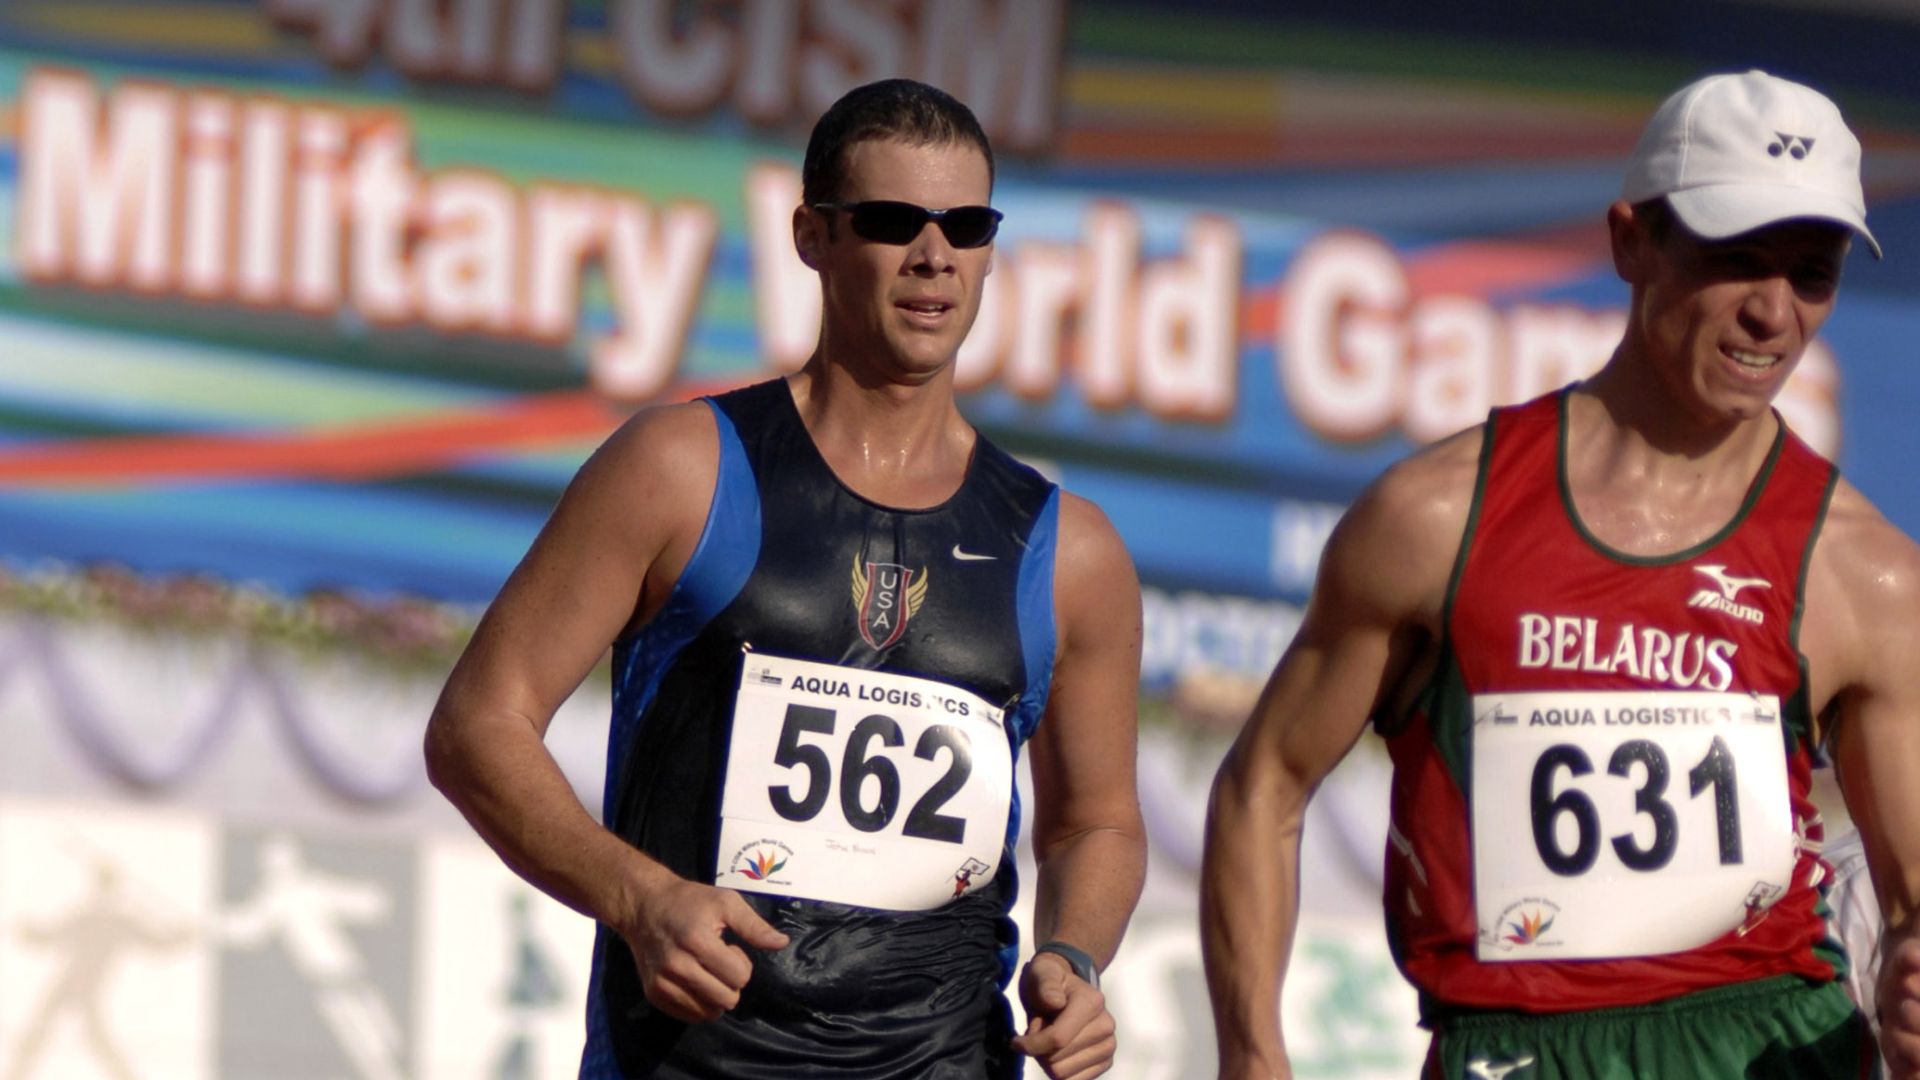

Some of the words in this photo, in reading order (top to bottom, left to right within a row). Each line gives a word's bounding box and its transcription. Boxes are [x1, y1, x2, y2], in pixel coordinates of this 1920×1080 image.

[20, 63, 714, 399] Military
[1278, 228, 1843, 465] Gam
[873, 571, 897, 629] USA
[1519, 613, 1739, 692] BELARUS
[791, 675, 851, 698] AQUA
[858, 684, 970, 718] LOGISCS
[1529, 709, 1596, 726] AQUA
[768, 703, 973, 844] 562
[1530, 734, 1744, 877] 631
